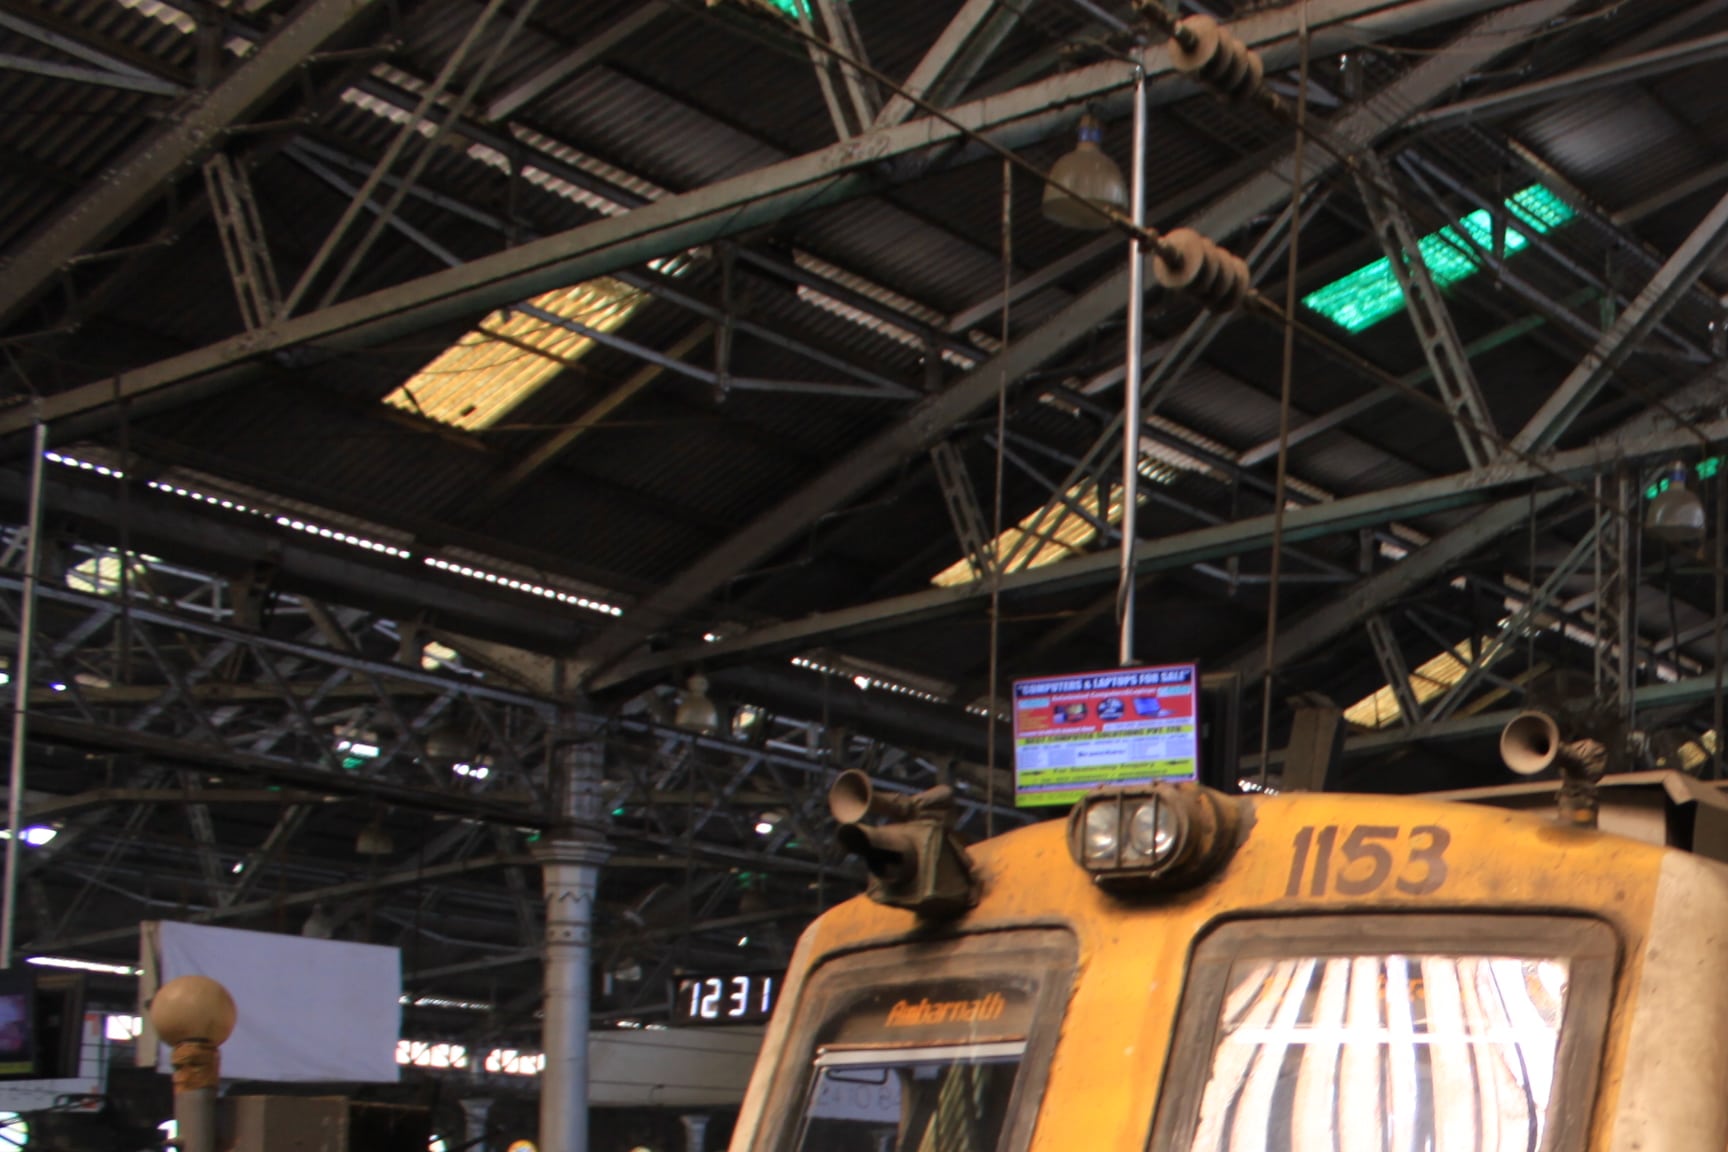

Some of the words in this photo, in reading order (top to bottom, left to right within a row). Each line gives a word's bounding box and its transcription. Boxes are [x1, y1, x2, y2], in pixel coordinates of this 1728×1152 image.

[1093, 674, 1138, 689] LAPTOPS
[1139, 671, 1159, 685] FOR
[1284, 825, 1451, 897] 1153
